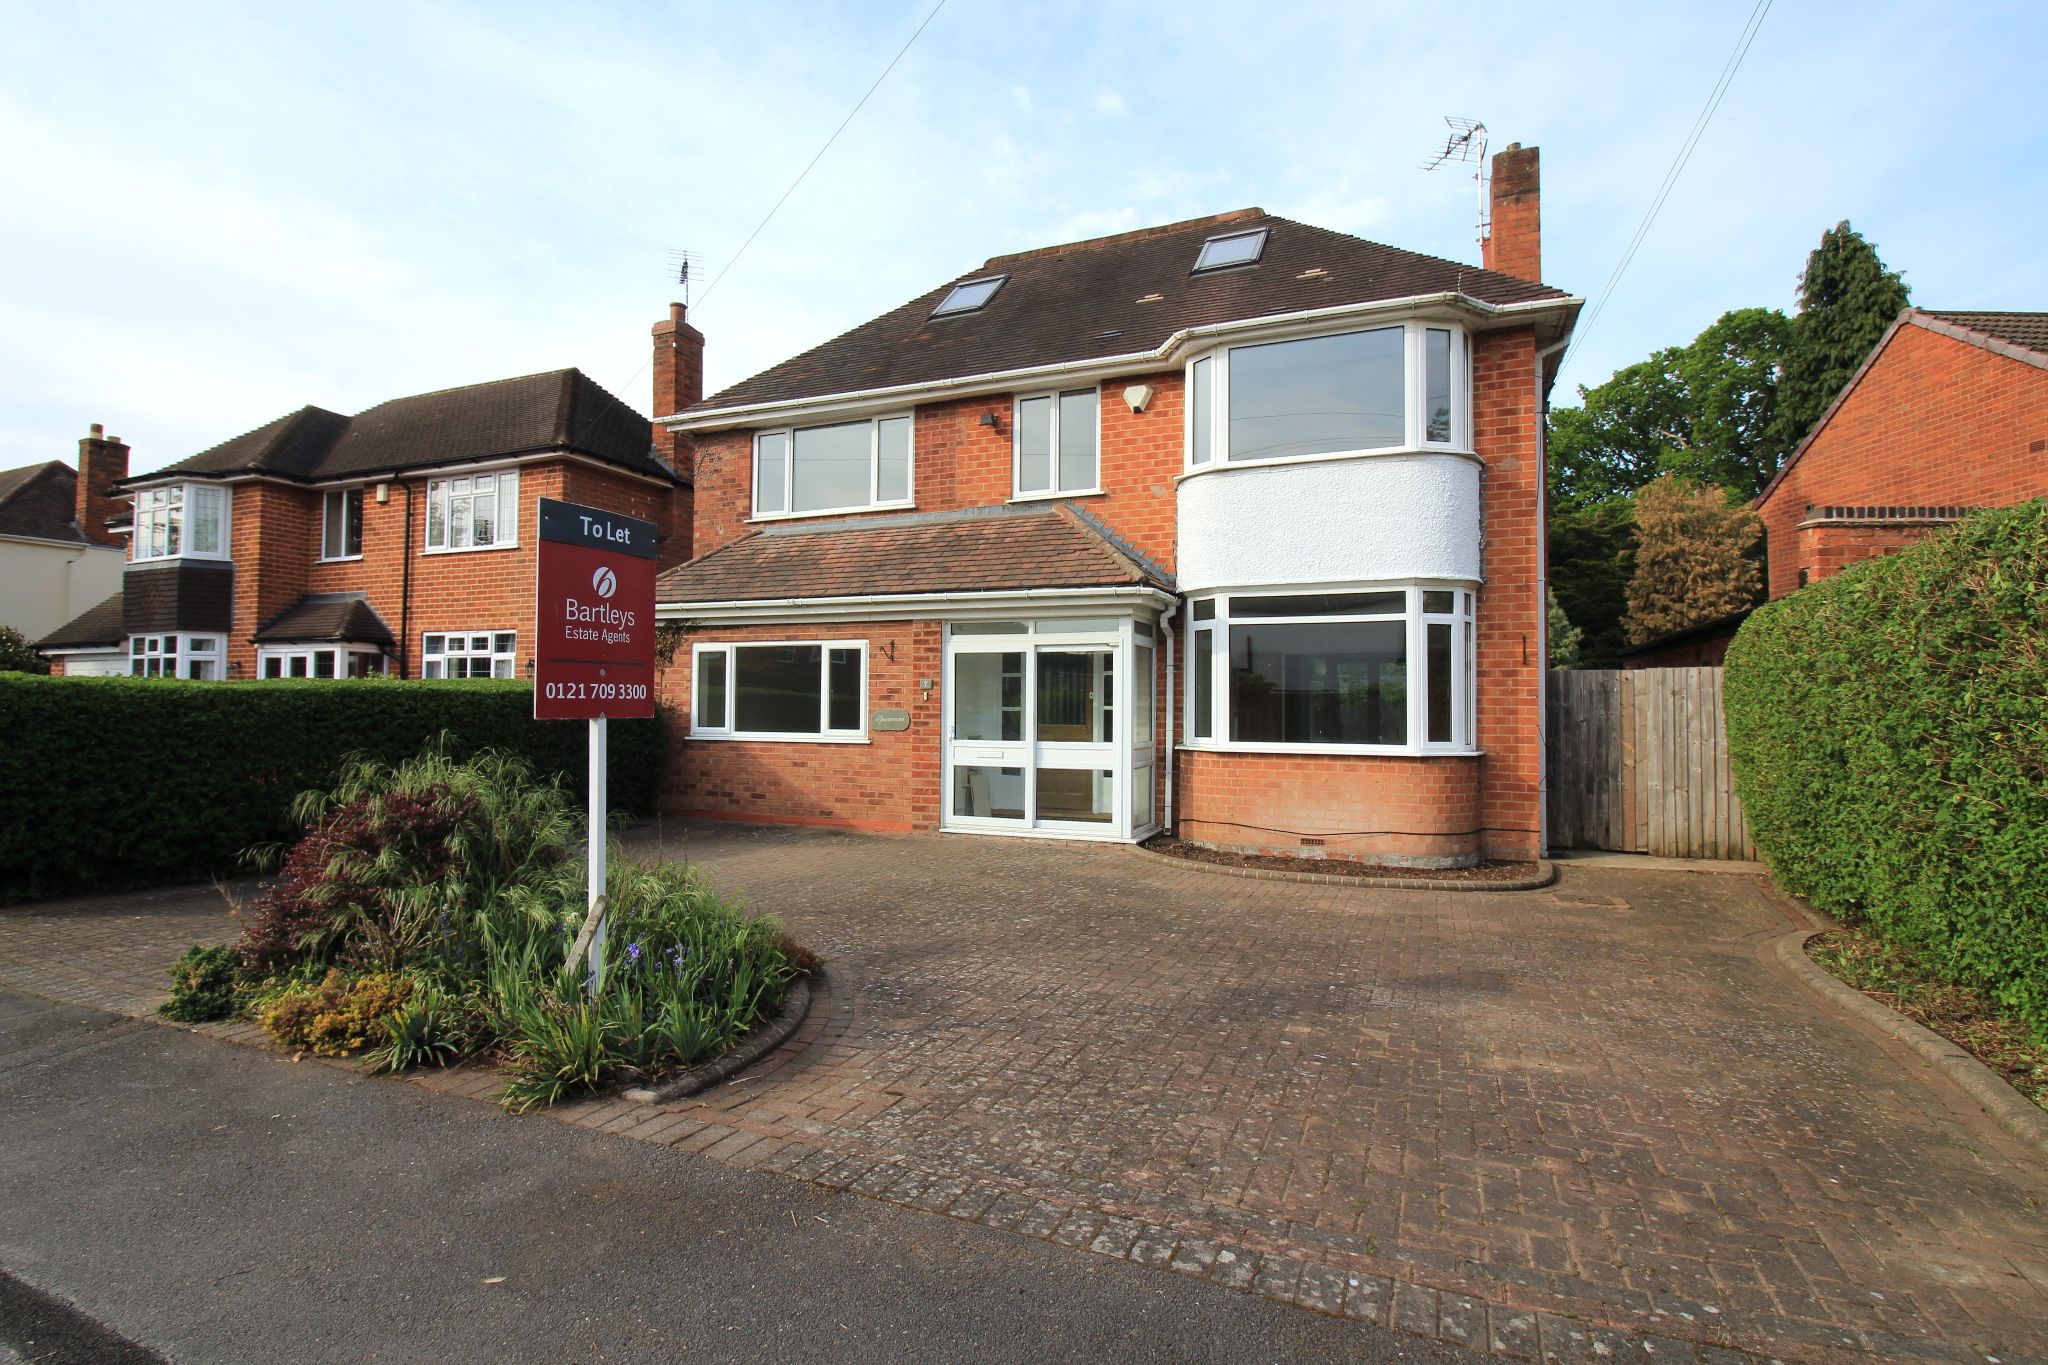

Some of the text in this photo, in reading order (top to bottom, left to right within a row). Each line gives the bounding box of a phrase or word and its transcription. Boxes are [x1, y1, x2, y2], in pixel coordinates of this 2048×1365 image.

[579, 515, 631, 545] To Let
[565, 598, 635, 630] Bartleys
[565, 625, 630, 644] Estate Agents
[545, 682, 647, 699] 0121 709 3300
